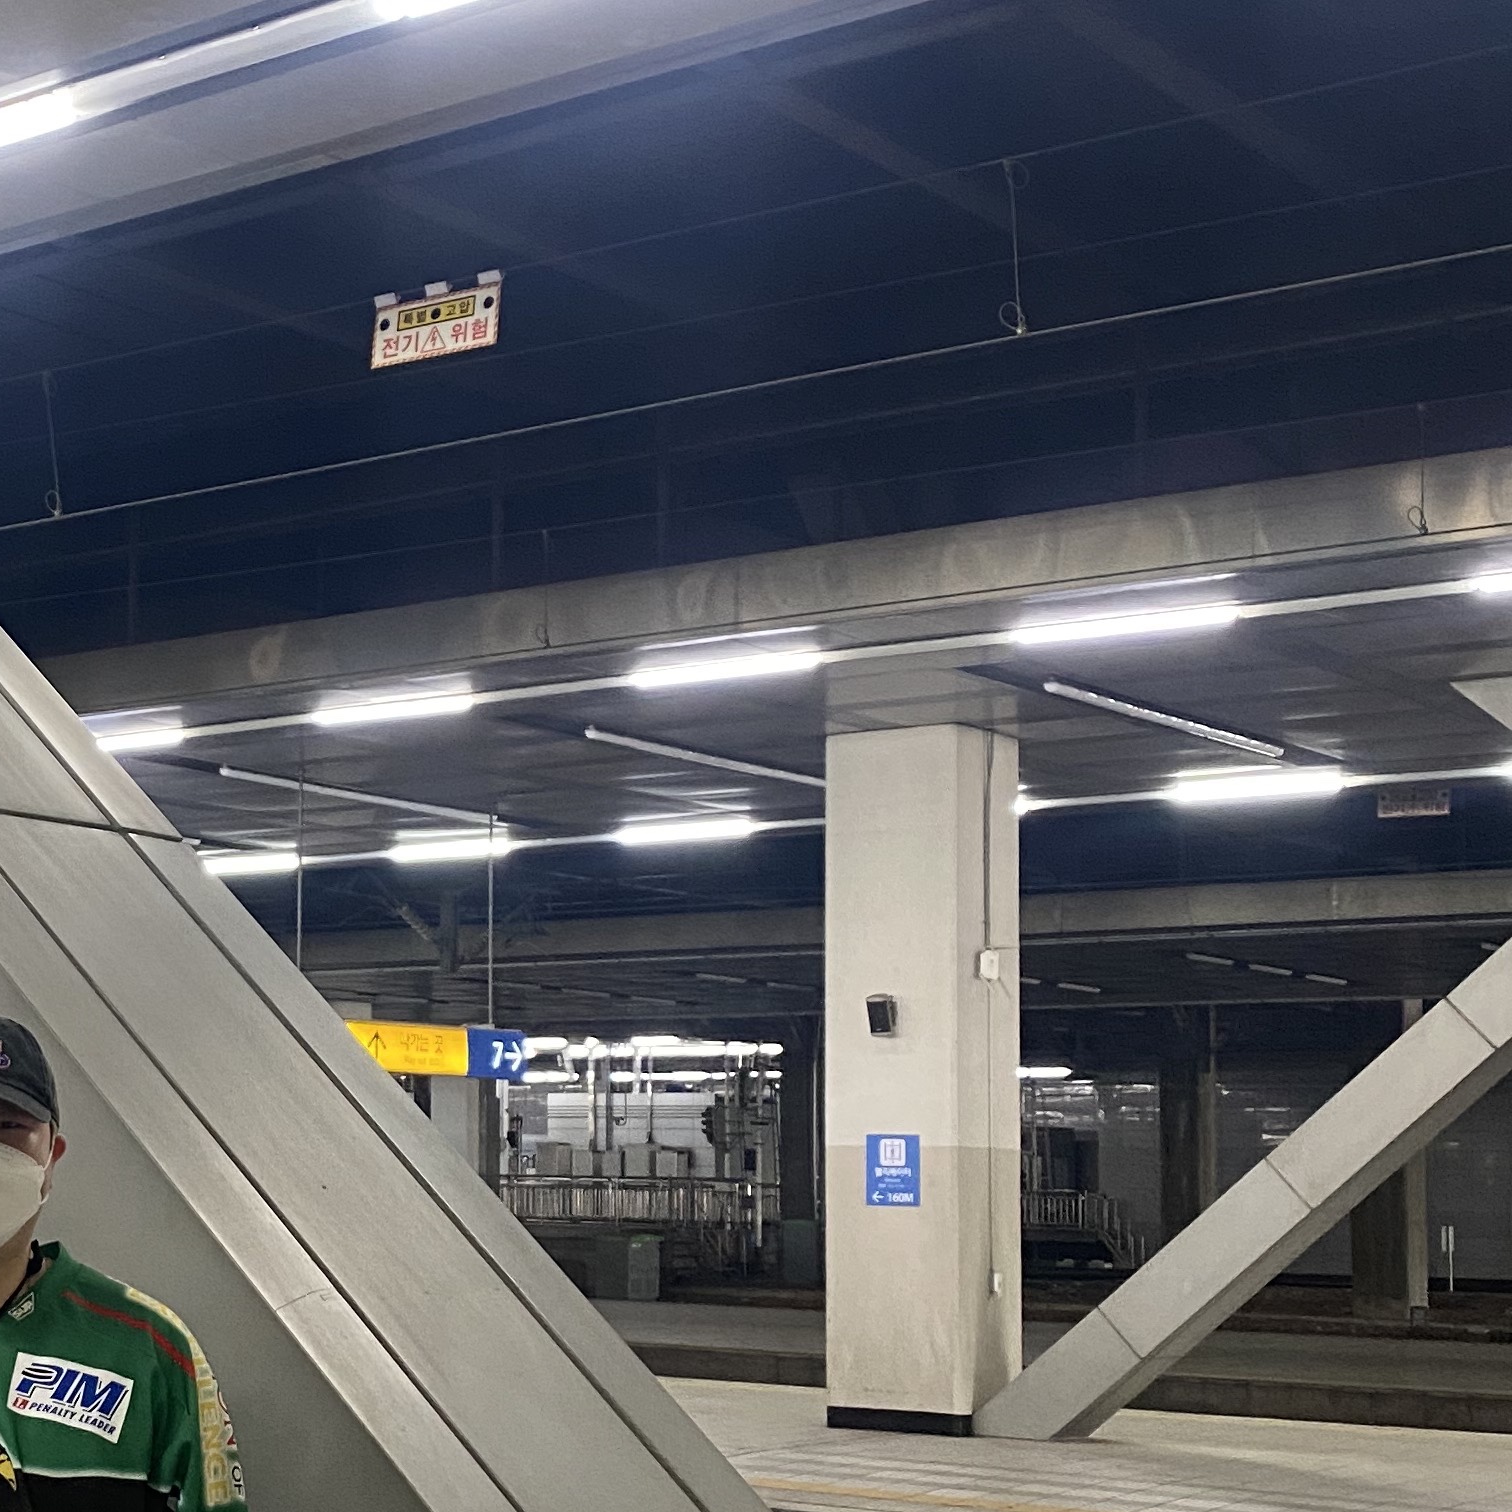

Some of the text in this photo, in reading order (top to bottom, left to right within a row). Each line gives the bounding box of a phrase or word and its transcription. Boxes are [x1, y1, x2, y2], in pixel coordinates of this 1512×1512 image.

[403, 301, 471, 324] 특별 고압
[381, 316, 489, 359] 전기 위험
[434, 1034, 444, 1054] 곳
[492, 1041, 504, 1070] 7
[887, 1192, 914, 1203] 160M
[15, 1362, 130, 1421] PIM
[28, 1402, 77, 1420] PENALTY
[79, 1413, 117, 1436] LEADER
